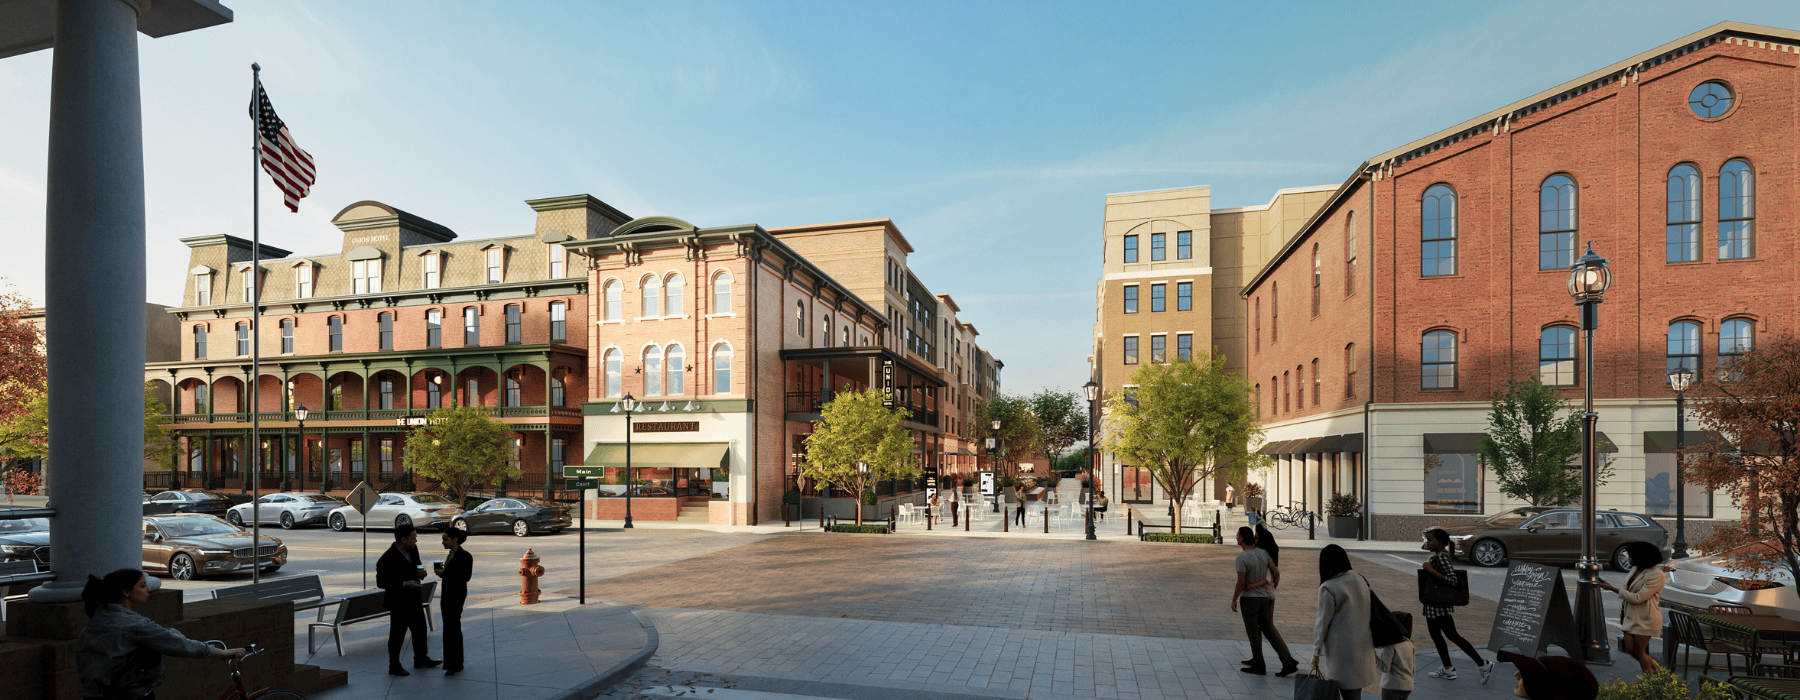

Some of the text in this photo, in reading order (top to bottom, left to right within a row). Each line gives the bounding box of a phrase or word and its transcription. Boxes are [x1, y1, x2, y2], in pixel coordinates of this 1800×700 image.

[396, 418, 406, 426] THE
[407, 417, 428, 426] UNION
[636, 422, 696, 431] RESTAURANT
